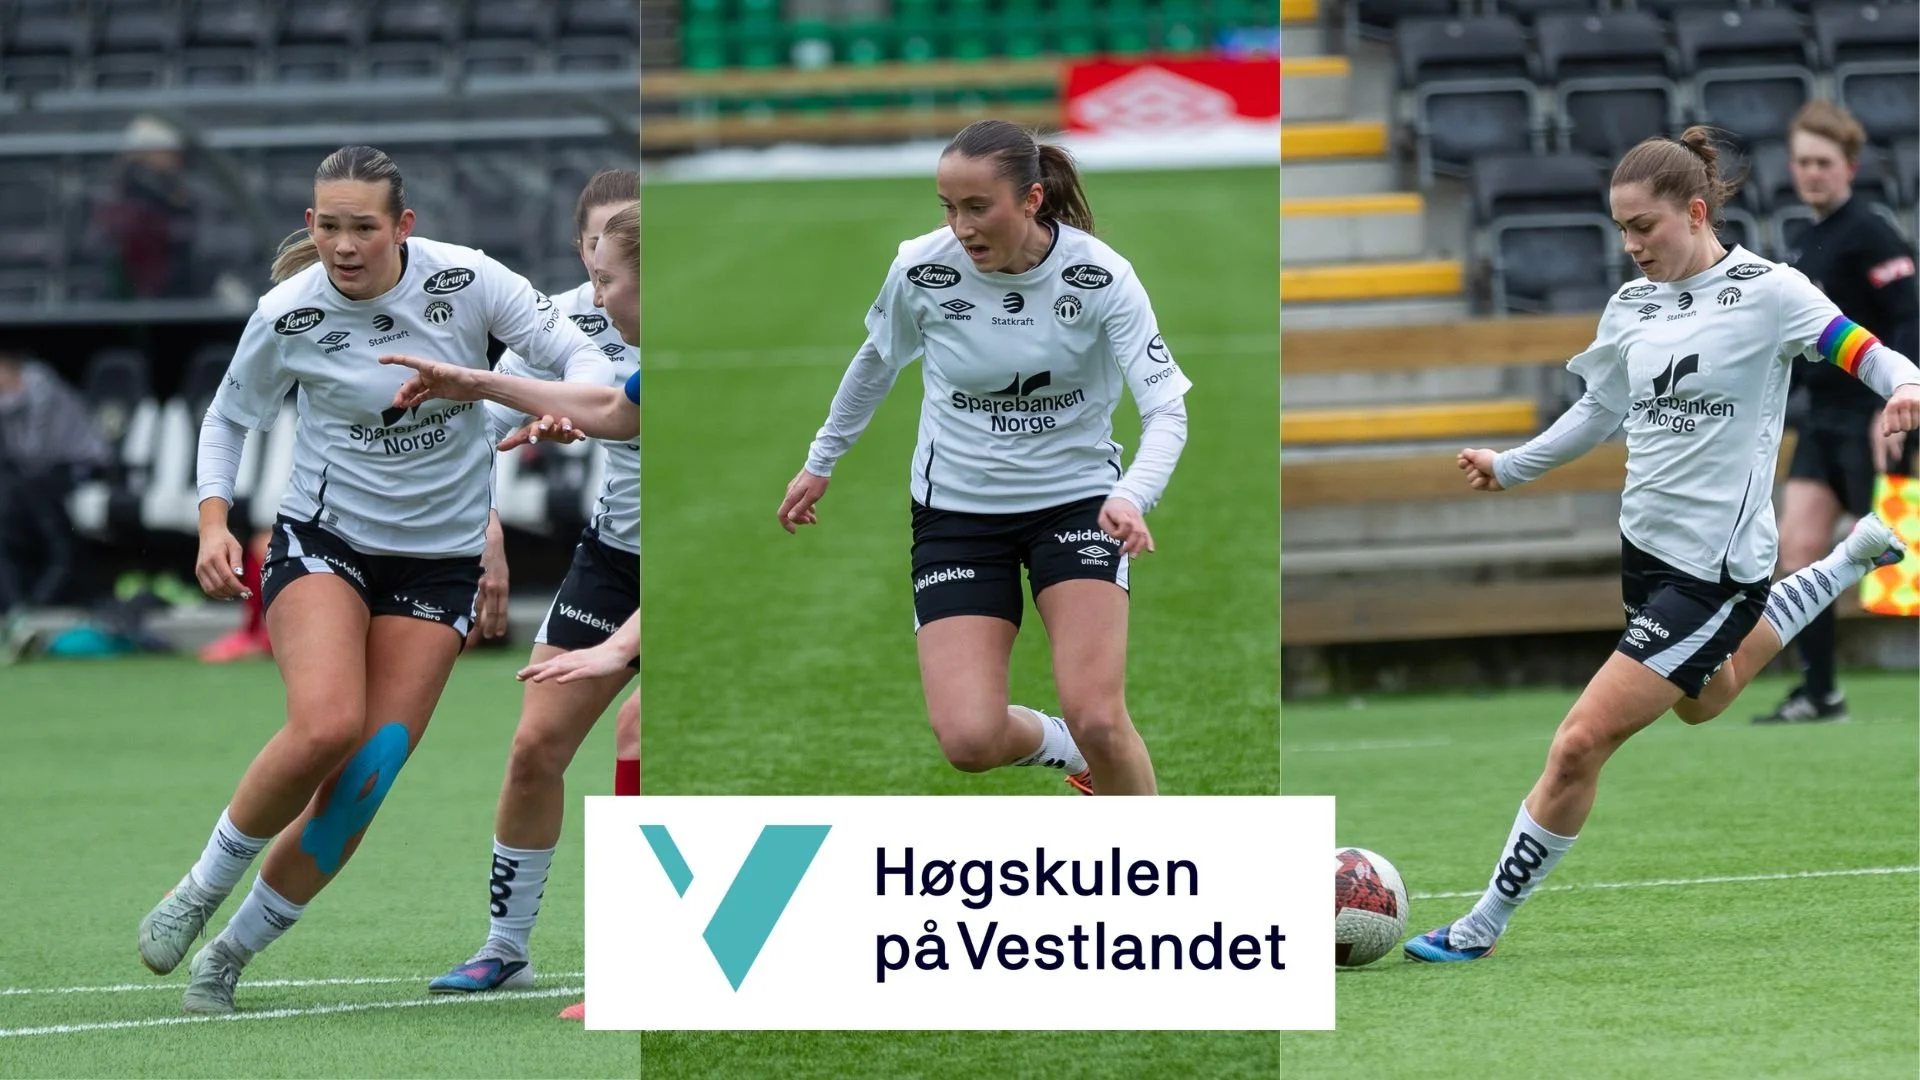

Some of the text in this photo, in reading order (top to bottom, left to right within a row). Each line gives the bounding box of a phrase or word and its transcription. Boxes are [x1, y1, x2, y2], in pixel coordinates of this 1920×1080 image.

[427, 272, 471, 293] Lerum
[909, 265, 956, 288] Lerum
[1064, 266, 1109, 288] Lerum
[277, 312, 321, 333] Lerum
[944, 312, 972, 321] umbro
[991, 316, 1035, 326] Statkraft
[1666, 309, 1698, 322] Statkraft
[324, 342, 351, 354] umbro
[368, 330, 410, 347] Statkraft
[952, 388, 1086, 414] Sparebanken
[991, 415, 1057, 434] Norge
[1647, 408, 1696, 434] Norge
[383, 428, 446, 455] Norge
[1081, 558, 1109, 567] umbro
[914, 567, 976, 593] Veidekke
[412, 609, 441, 621] umbro
[559, 602, 621, 635] Veidekk
